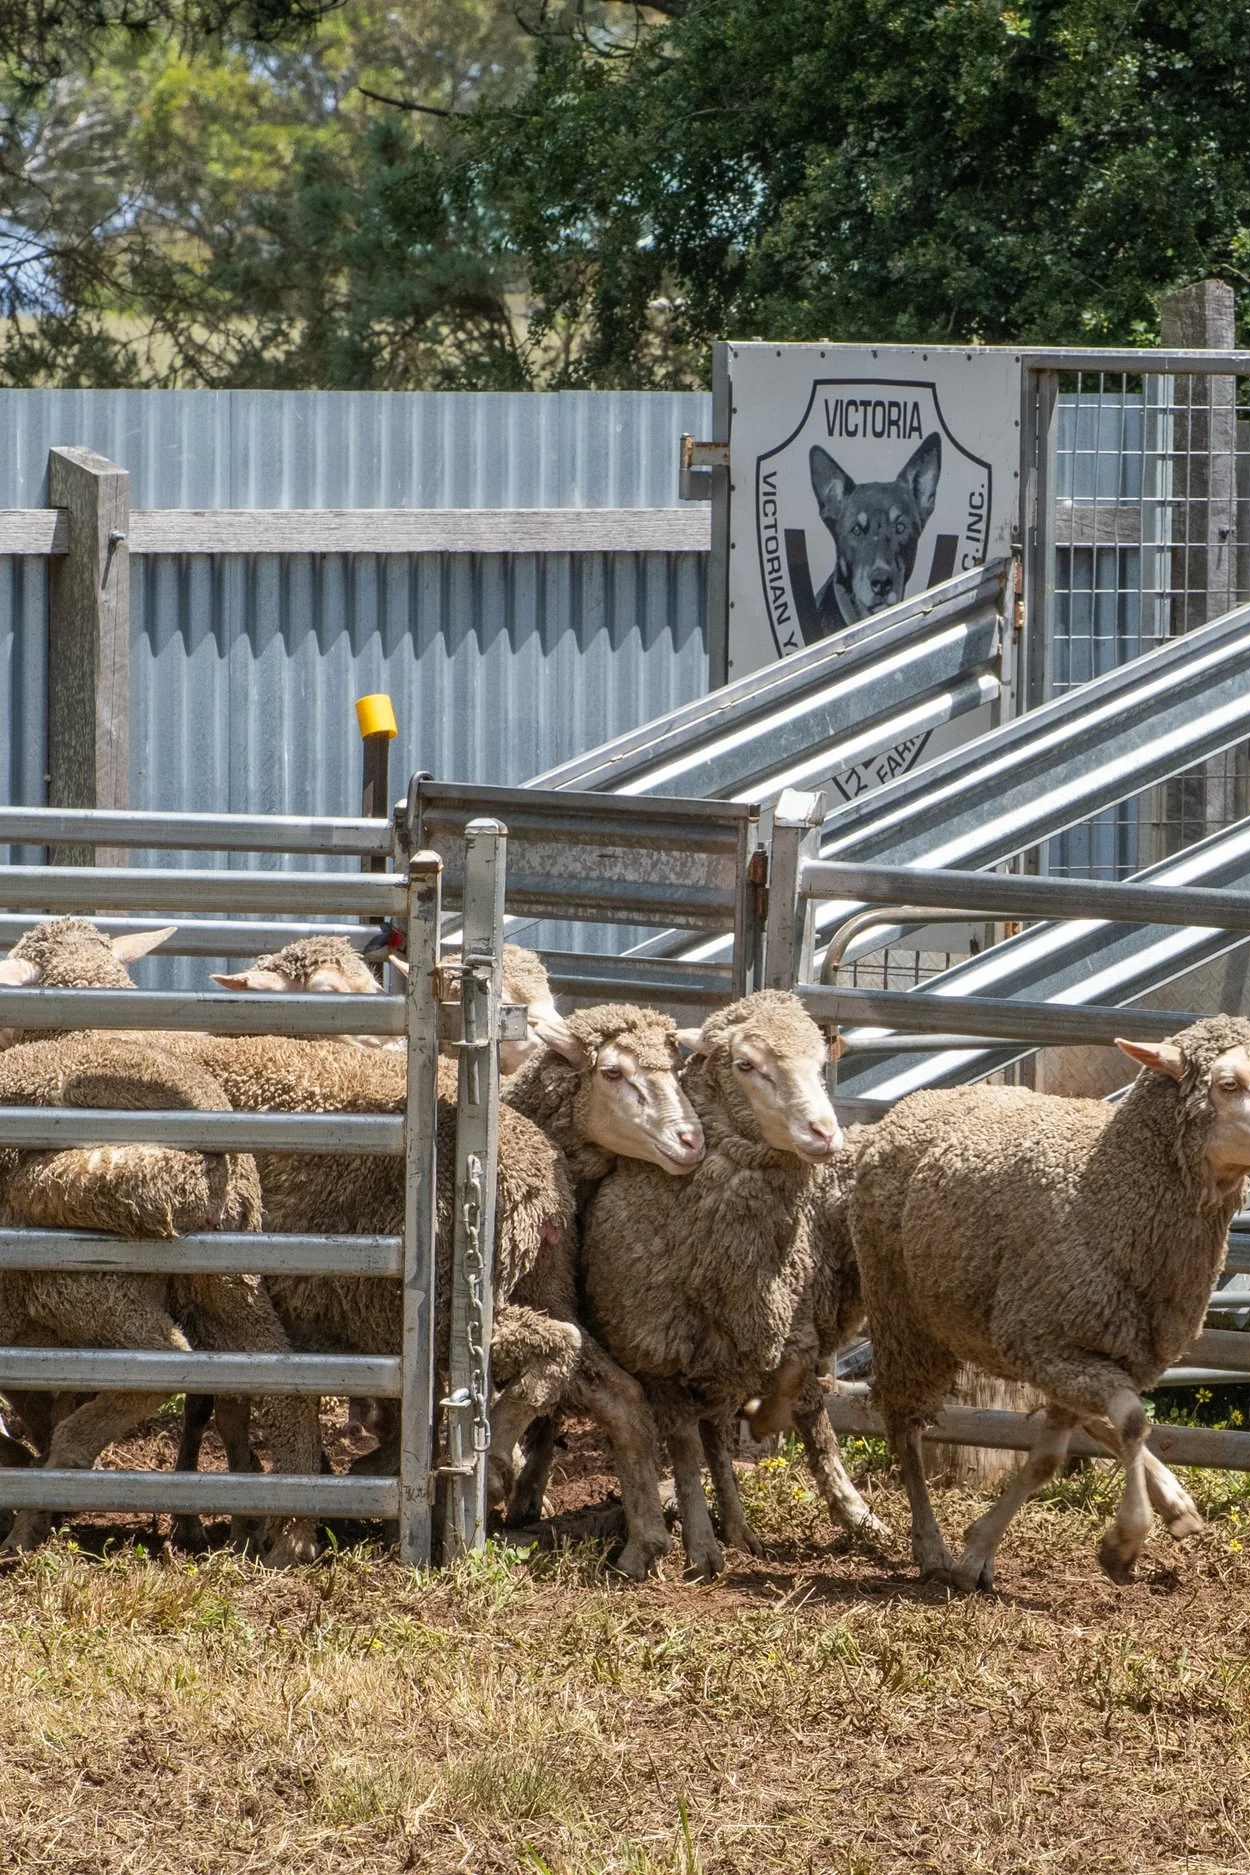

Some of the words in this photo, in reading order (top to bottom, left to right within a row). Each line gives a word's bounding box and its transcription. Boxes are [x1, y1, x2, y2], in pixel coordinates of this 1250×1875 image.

[824, 398, 923, 439] VICTORIA
[762, 471, 791, 626] VICTORIAN
[876, 735, 920, 784] FAR
